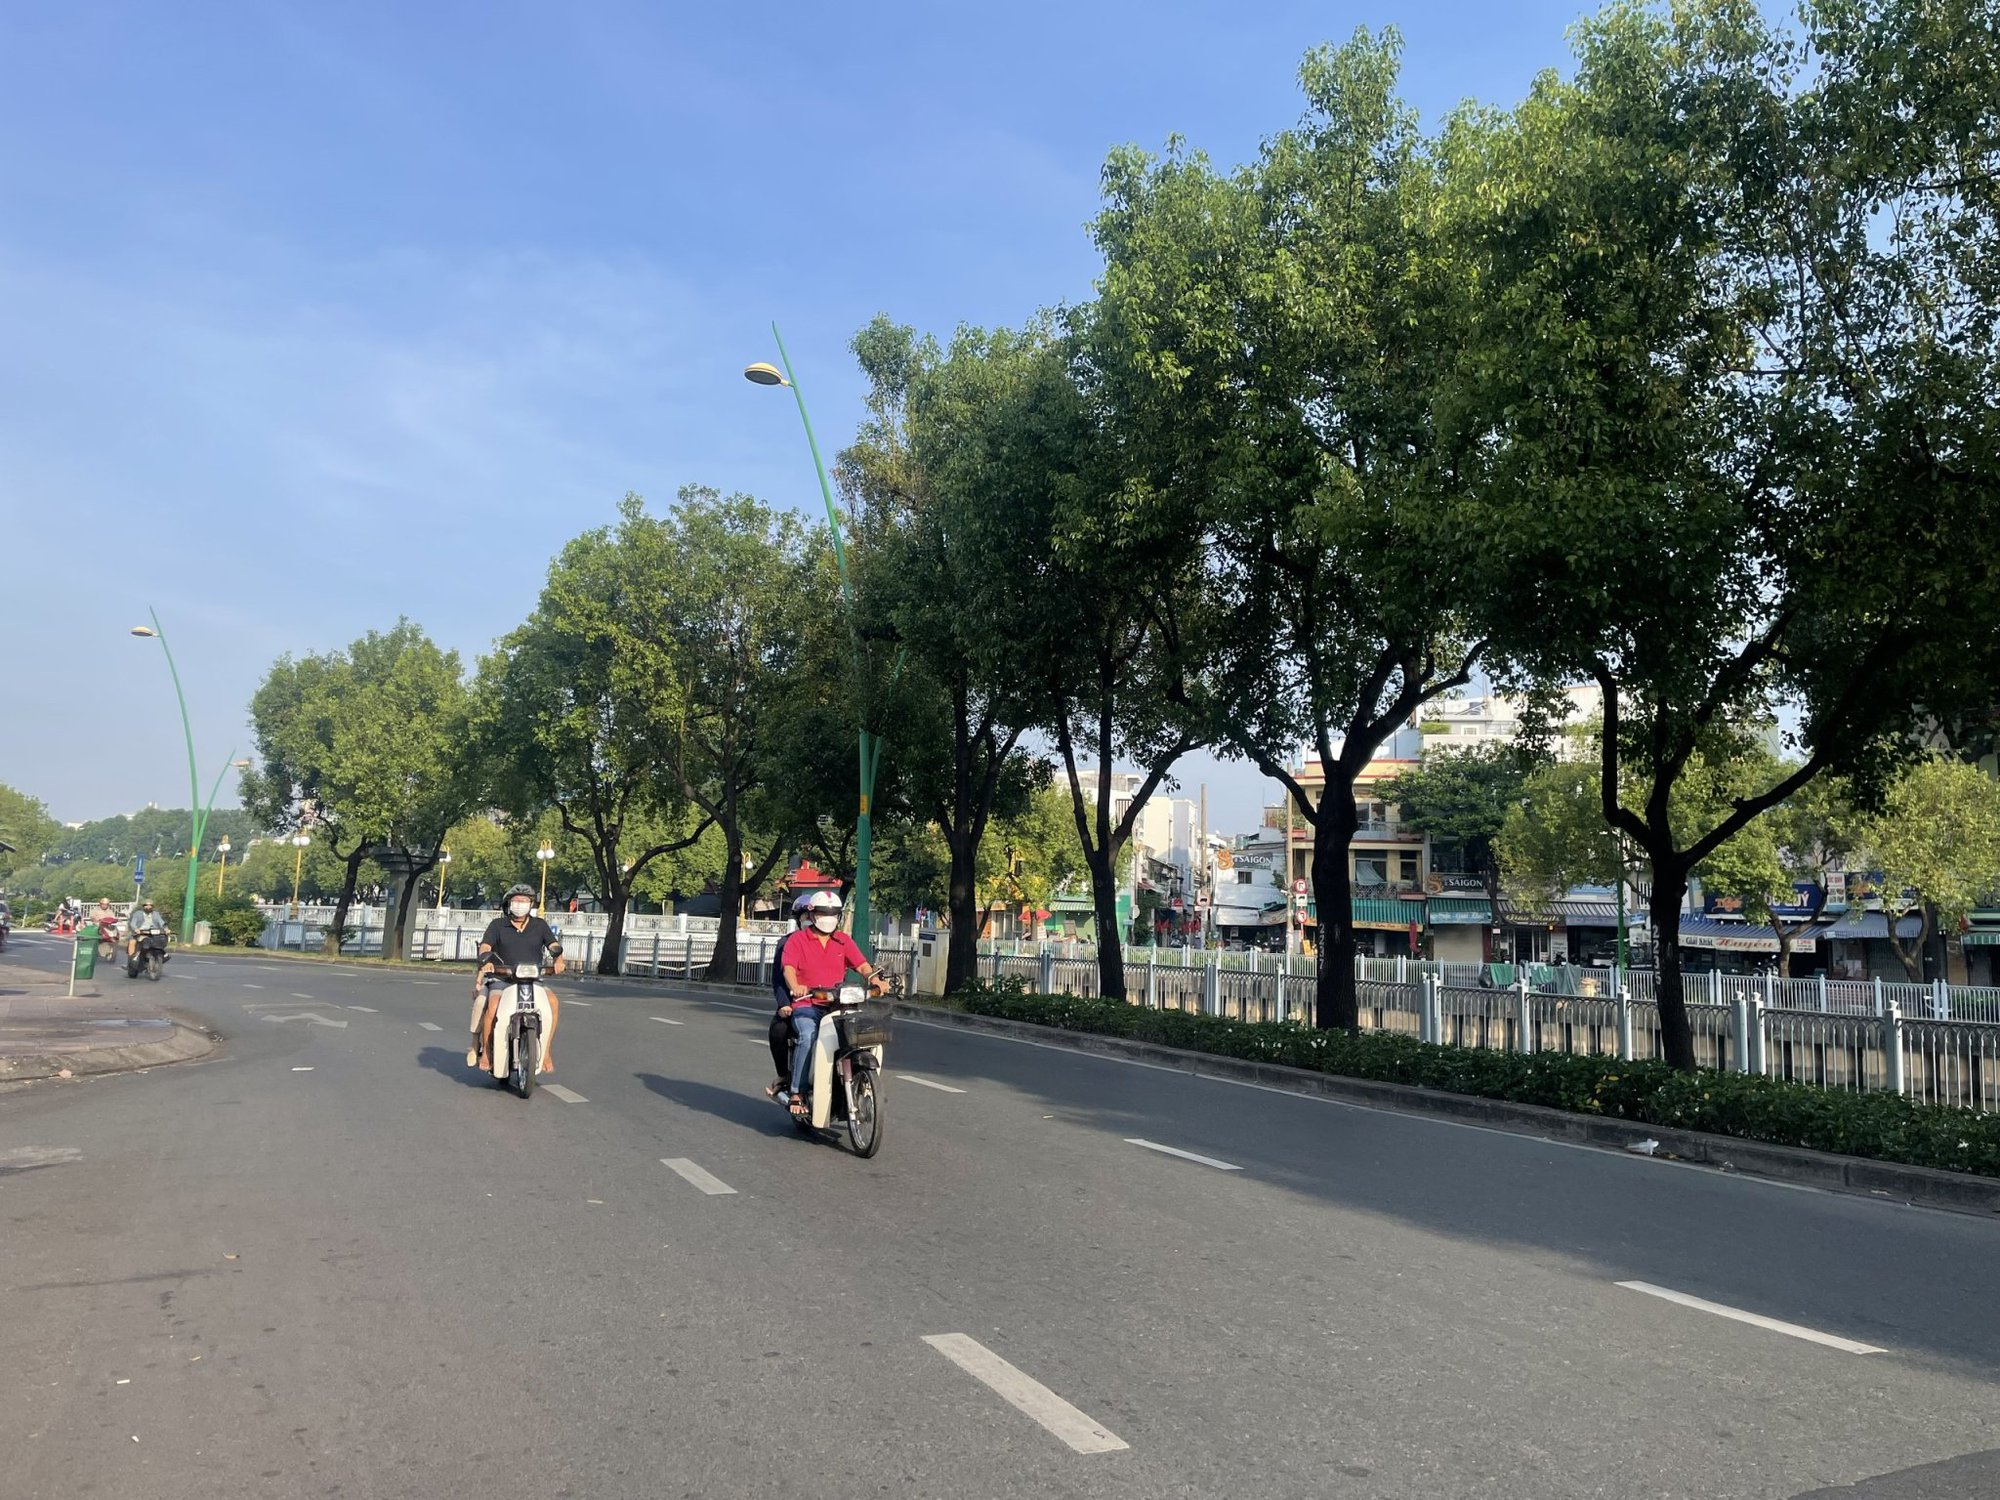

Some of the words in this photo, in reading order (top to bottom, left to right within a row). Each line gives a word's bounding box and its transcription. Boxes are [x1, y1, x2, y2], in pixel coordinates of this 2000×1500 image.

[1239, 855, 1272, 864] SAIGON
[1448, 878, 1483, 888] SAIGON
[1652, 923, 1662, 985] 2235
